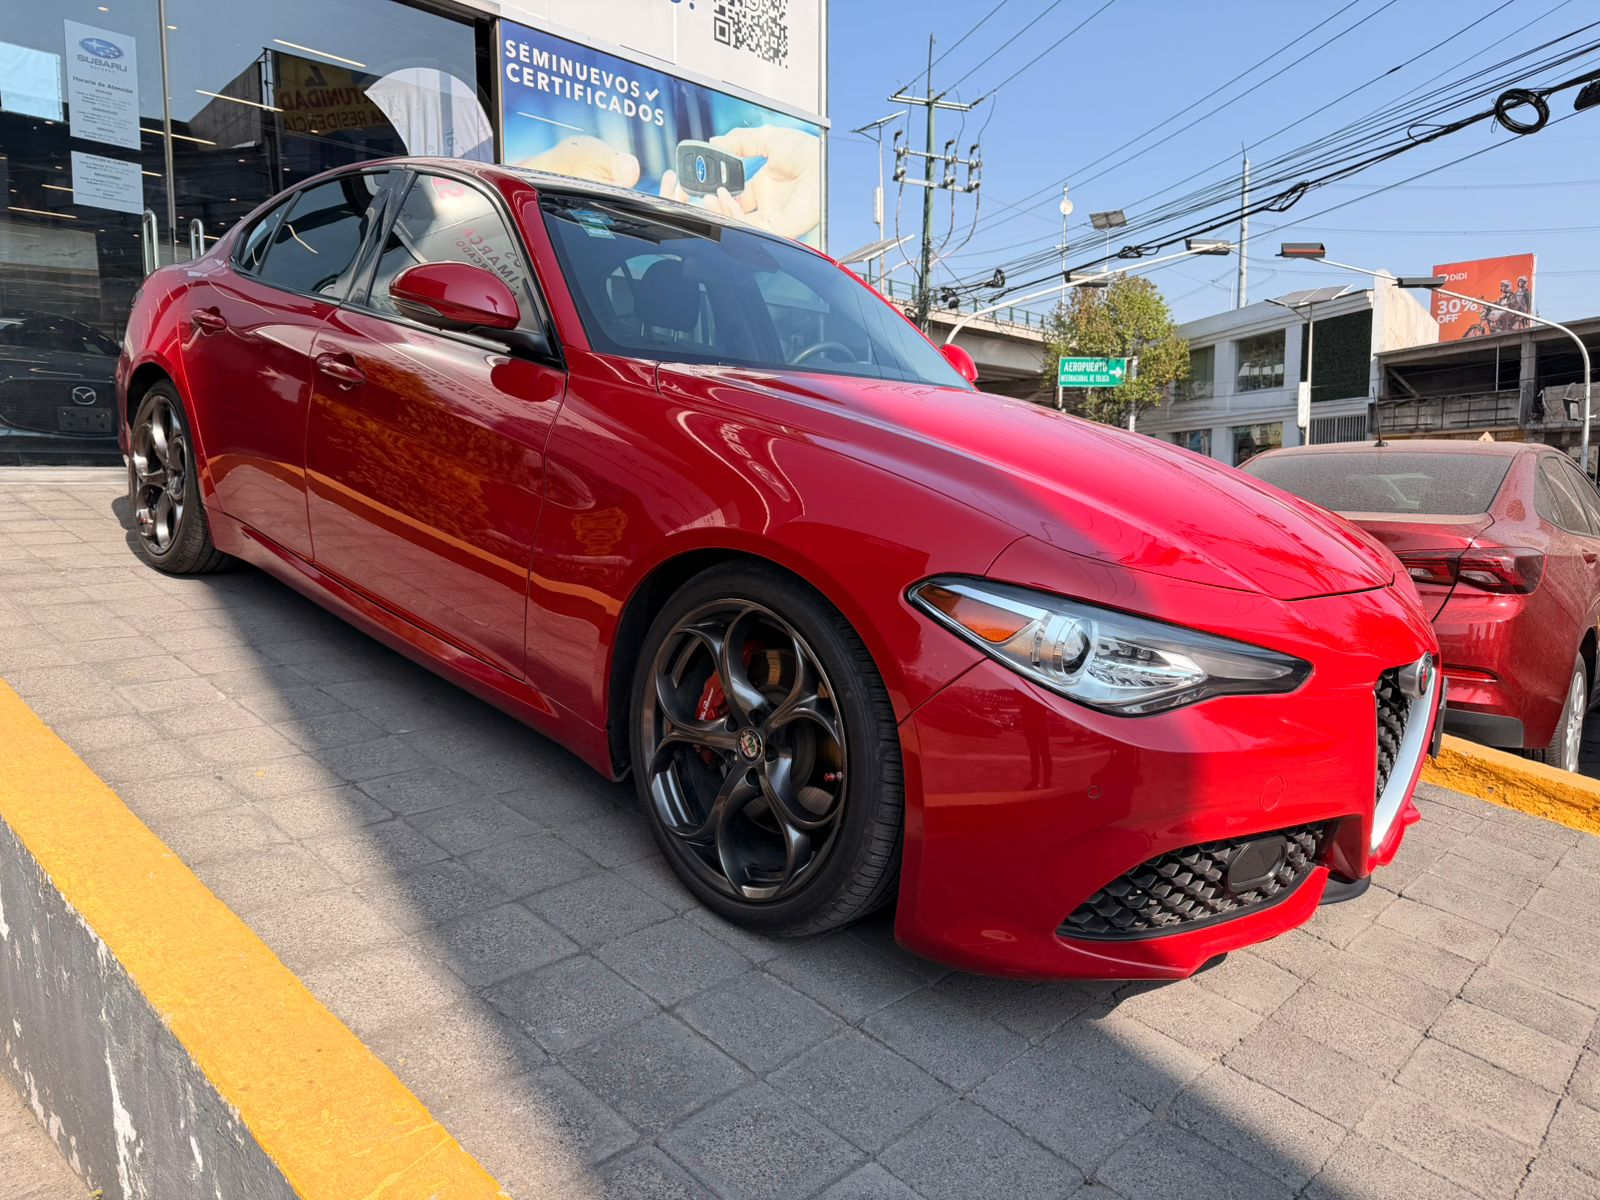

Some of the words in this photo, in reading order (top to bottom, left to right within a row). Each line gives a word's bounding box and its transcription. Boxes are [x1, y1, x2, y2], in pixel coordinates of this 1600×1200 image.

[76, 54, 128, 72] SUBARU
[505, 39, 640, 98] SEMINUEVOS
[505, 62, 664, 127] CERTIFICADOS
[1437, 299, 1478, 315] 30%
[1063, 361, 1107, 372] AEROPUERTO
